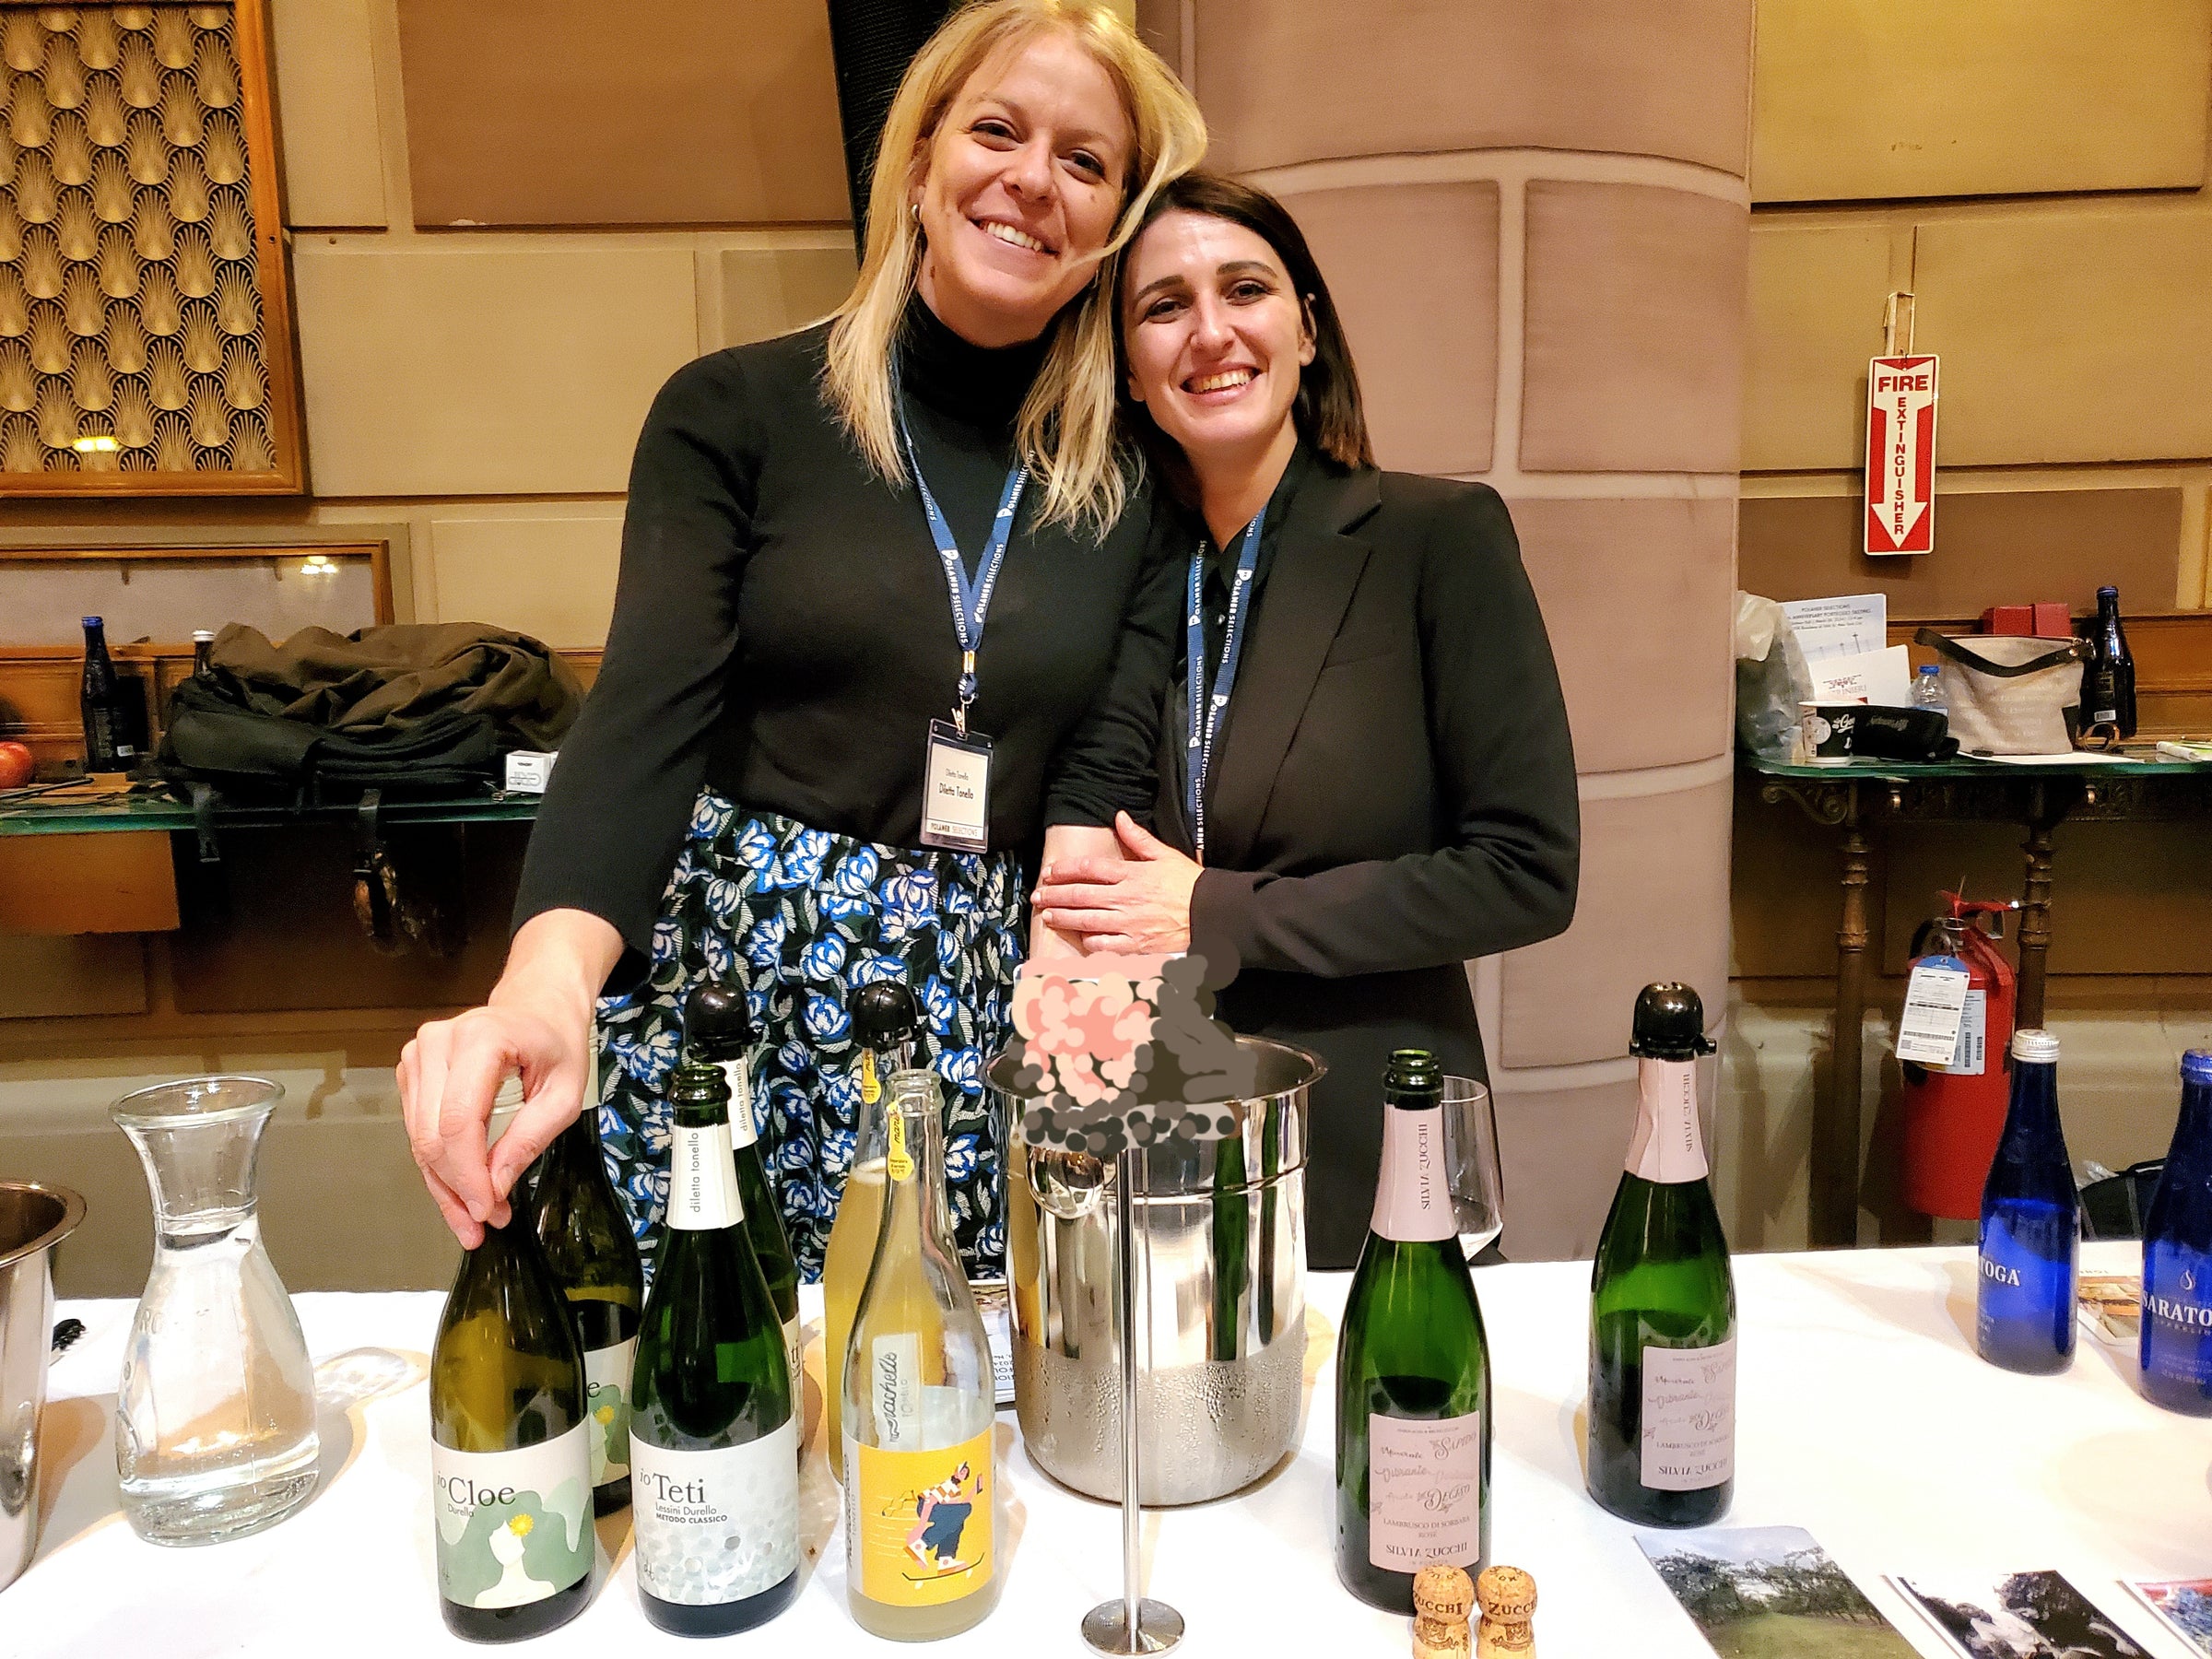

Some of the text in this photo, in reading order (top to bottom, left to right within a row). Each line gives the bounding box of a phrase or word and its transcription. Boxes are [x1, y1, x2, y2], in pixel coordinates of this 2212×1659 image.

[1878, 375, 1929, 392] FIRE
[1894, 397, 1907, 535] EXTINGUISHER
[985, 543, 1004, 583] SELECTIONS
[953, 595, 968, 644] SELECTIONS
[1222, 615, 1236, 665] SELECTIONS
[939, 783, 974, 800] Diletta Tonello
[1195, 778, 1204, 826] SELECTIONS
[734, 1063, 748, 1131] diletta tonello
[1683, 1074, 1691, 1116] ZUCCHI
[688, 1133, 700, 1212] diletta tonello
[1418, 1124, 1431, 1210] SILVIA ZUCCHI
[1981, 1257, 2020, 1287] TOGA
[2142, 1290, 2212, 1327] SARATO
[1659, 1458, 1728, 1475] SILVIA ZUCCHI
[448, 1477, 516, 1506] Cloe
[640, 1468, 706, 1504] io Teti
[656, 1501, 717, 1515] Lessini Durello
[656, 1513, 727, 1524] METODO CLASSICO
[1383, 1518, 1429, 1529] LAMBRUSCO
[1386, 1541, 1467, 1558] SILVIA ZUCCHI
